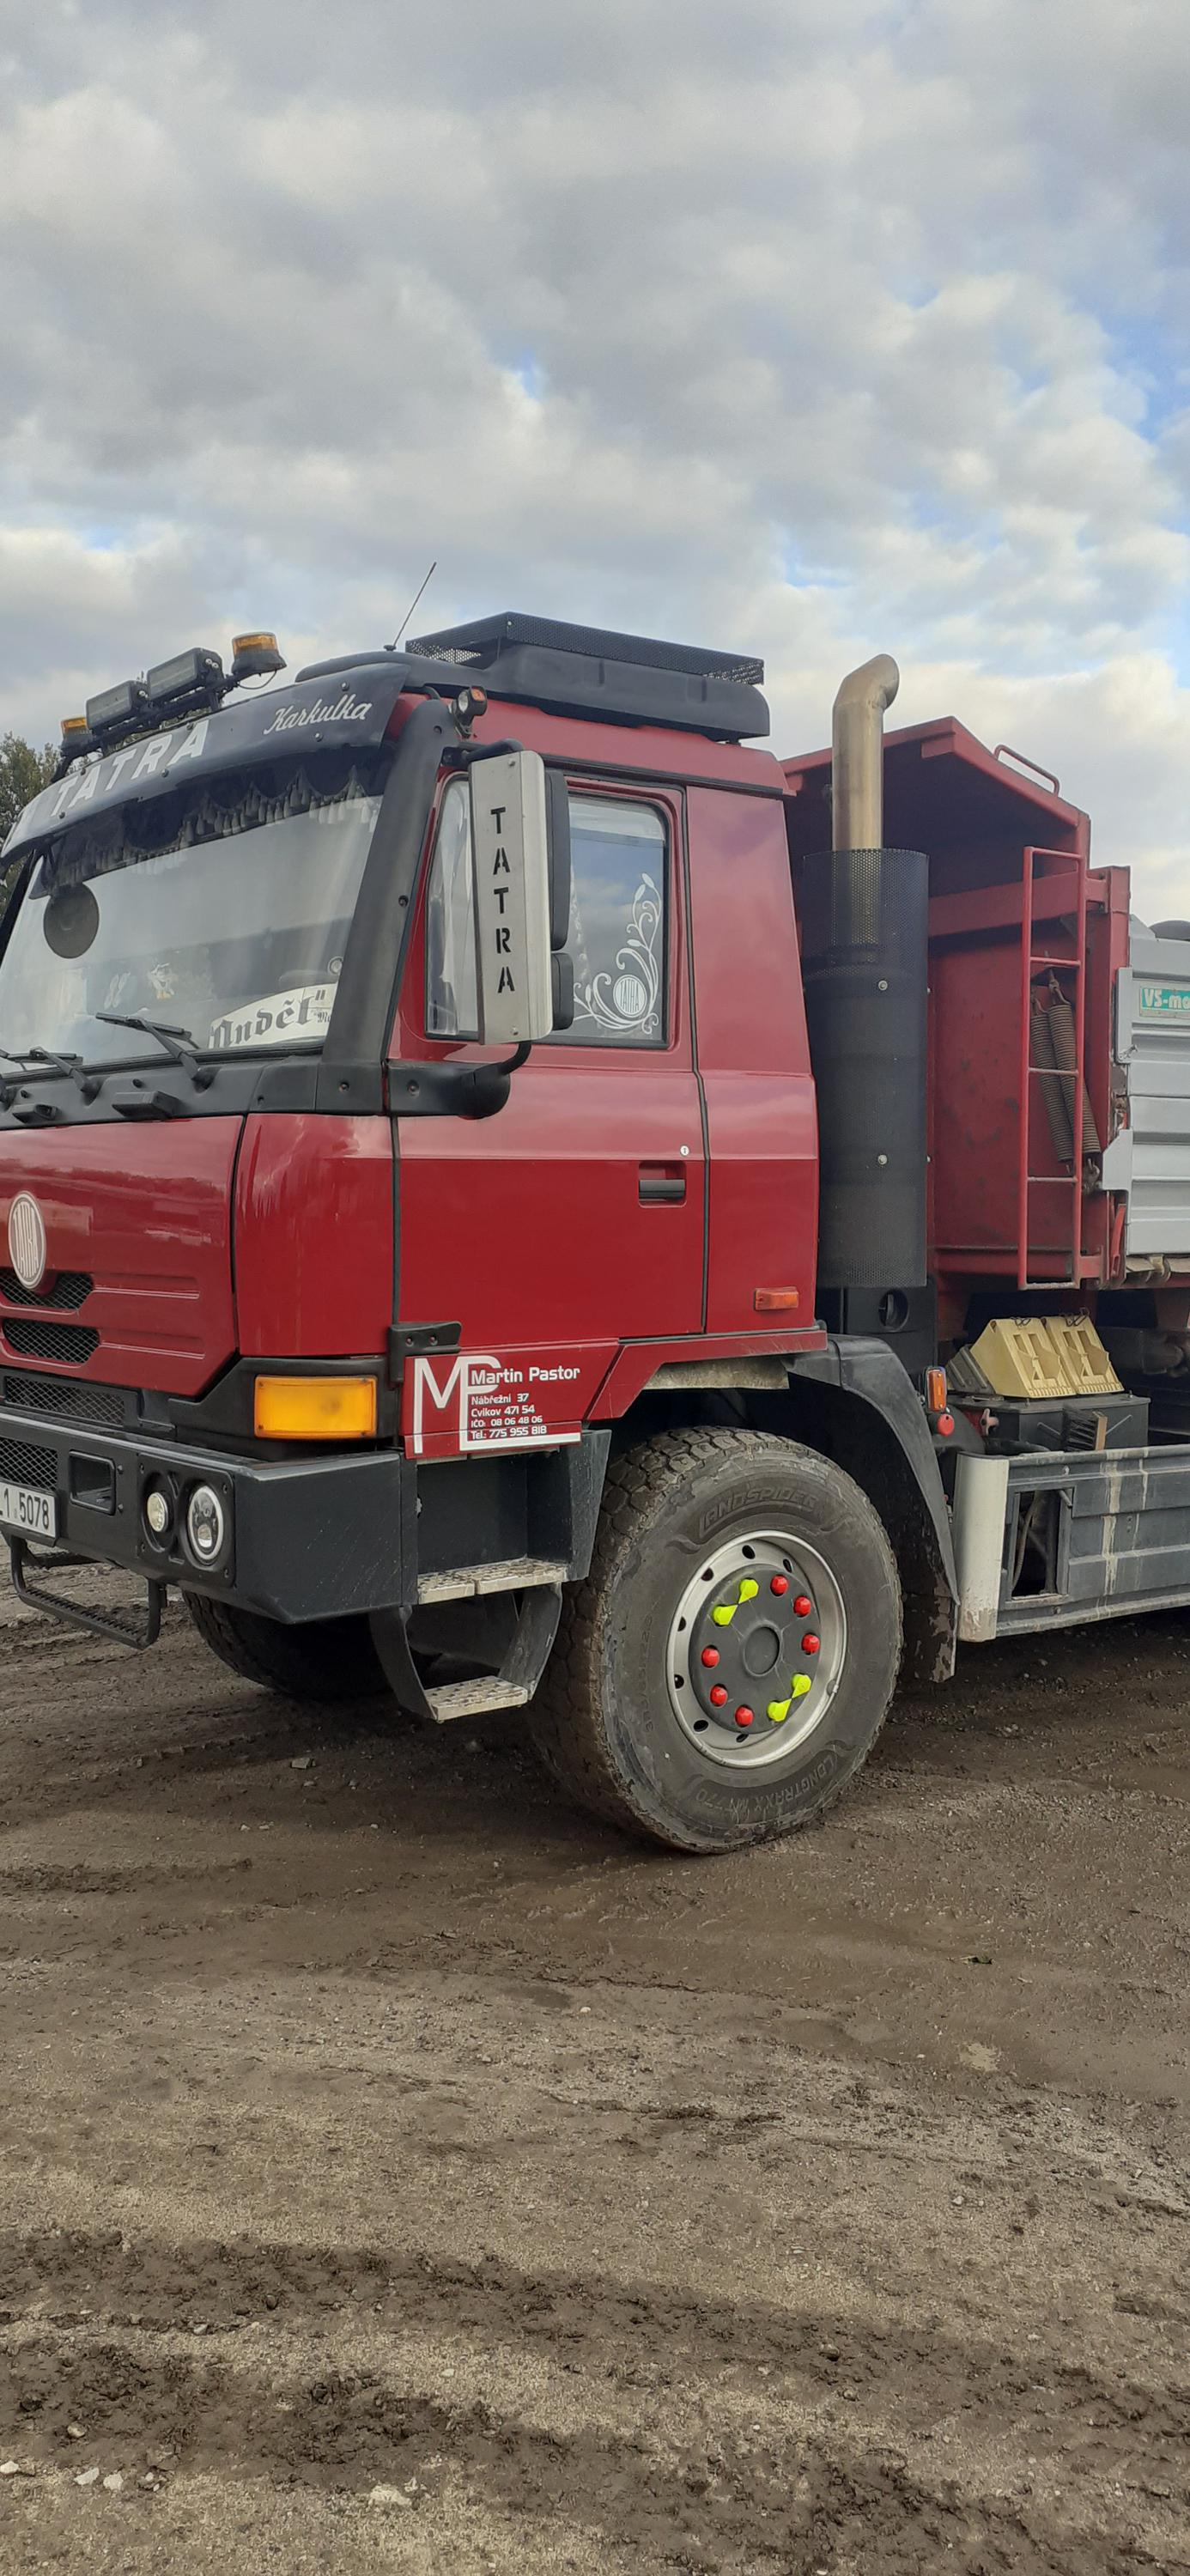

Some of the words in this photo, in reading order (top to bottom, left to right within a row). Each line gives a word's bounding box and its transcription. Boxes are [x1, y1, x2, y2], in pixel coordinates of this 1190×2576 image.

[263, 693, 372, 735] Karkulka
[51, 720, 209, 817] TATRA
[490, 806, 515, 993] TATRA
[471, 1368, 523, 1385] Martin
[529, 1365, 580, 1382] Pastor
[516, 1393, 530, 1403] 37
[471, 1407, 501, 1418] Cvikov
[504, 1406, 519, 1415] 471
[521, 1404, 536, 1414] 54
[490, 1418, 502, 1426] 08
[504, 1417, 516, 1425] 06
[518, 1416, 530, 1425] 48
[531, 1415, 543, 1424] 06
[489, 1428, 507, 1438] 775
[509, 1426, 529, 1437] 955
[531, 1425, 547, 1435] 818
[19, 1492, 50, 1529] 5078
